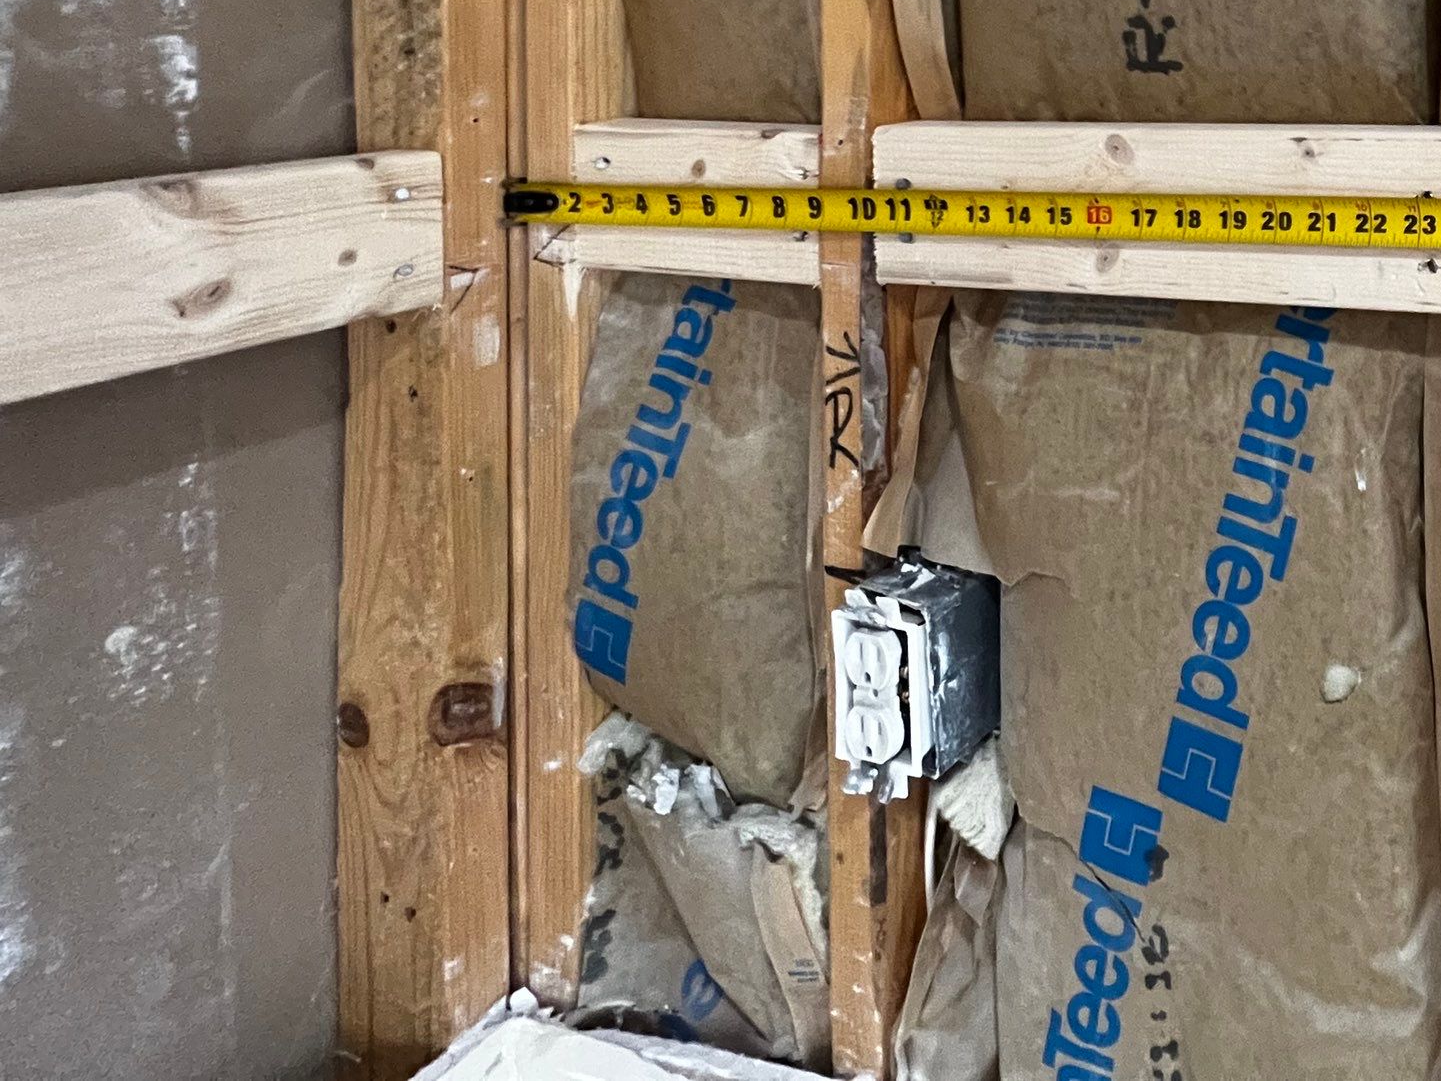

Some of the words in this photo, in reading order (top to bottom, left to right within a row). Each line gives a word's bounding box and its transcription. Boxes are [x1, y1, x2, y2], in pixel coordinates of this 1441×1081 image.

[567, 192, 582, 213] 2
[601, 192, 616, 215] 3
[635, 193, 649, 215] 4
[666, 193, 682, 216] 5
[701, 194, 717, 217] 6
[734, 194, 750, 218] 7
[771, 195, 786, 219] 8
[807, 195, 823, 219] 9
[848, 196, 878, 221] 10
[884, 197, 913, 222] 11
[965, 204, 992, 224] 13
[1005, 205, 1031, 224] 14
[1046, 206, 1074, 226] 15
[1088, 206, 1110, 224] 16
[1130, 208, 1158, 227] 17
[1174, 209, 1202, 229] 18
[1218, 210, 1248, 230] 19
[1260, 211, 1293, 232] 20
[1306, 212, 1338, 233] 21
[1354, 213, 1388, 235] 22
[1402, 214, 1437, 235] 23
